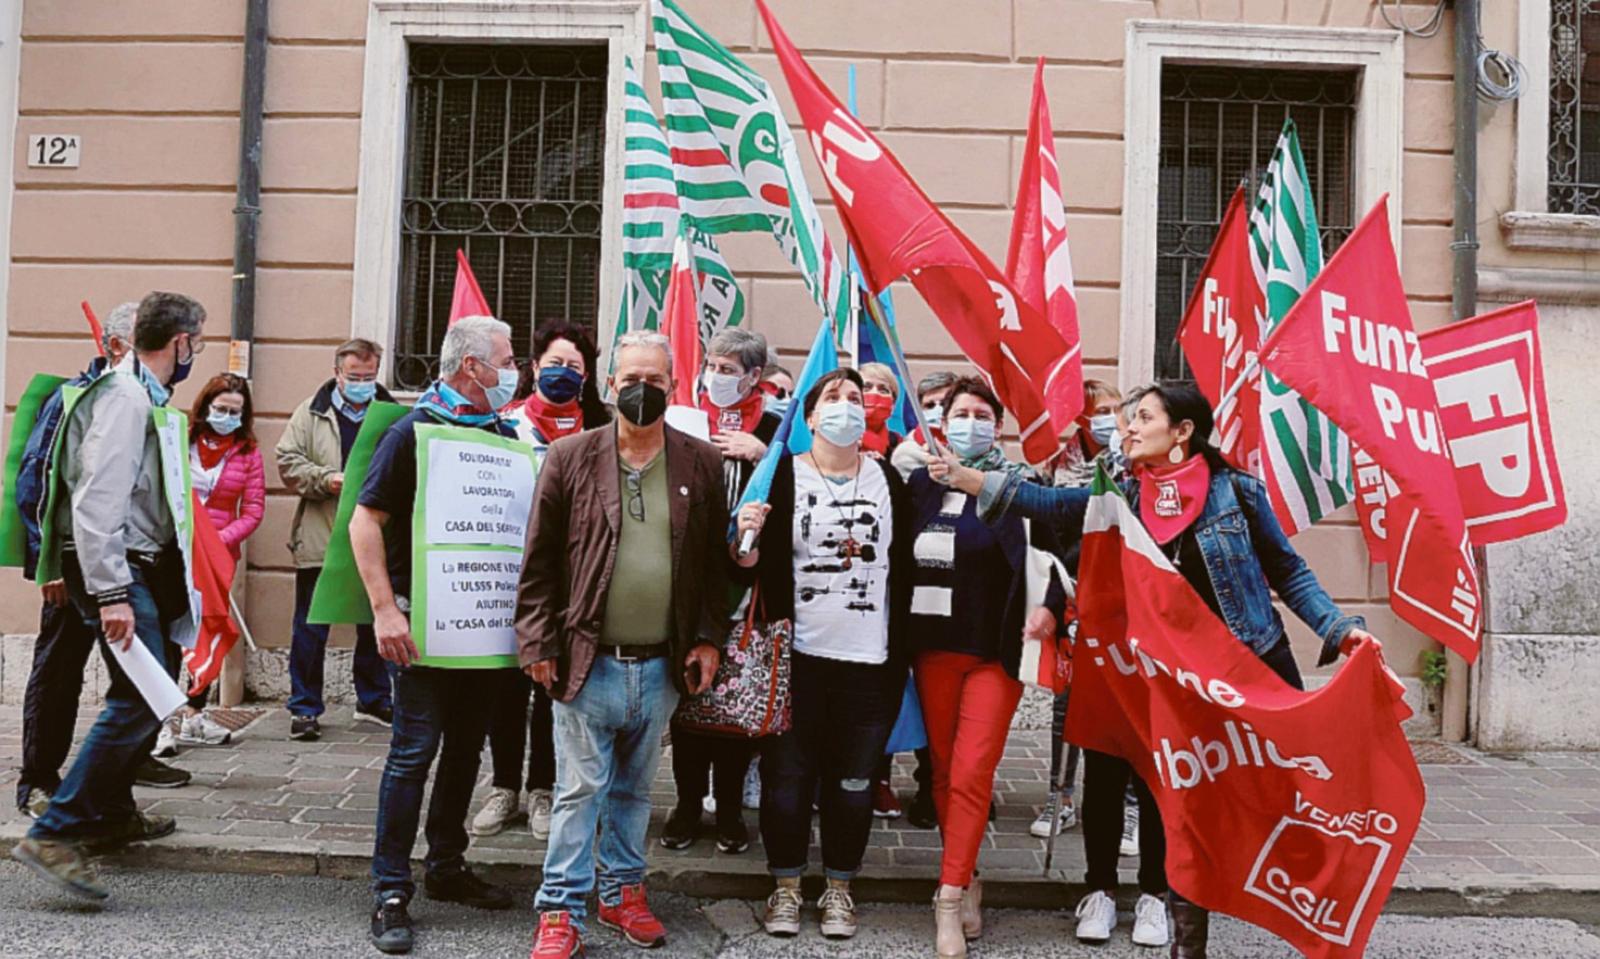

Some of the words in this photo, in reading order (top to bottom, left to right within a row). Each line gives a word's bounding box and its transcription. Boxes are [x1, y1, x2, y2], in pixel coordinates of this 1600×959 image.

[1370, 382, 1442, 455] Pu
[1432, 358, 1530, 498] FP
[444, 520, 474, 532] CASA
[475, 521, 495, 533] DEL
[457, 561, 503, 573] REGIONE
[487, 618, 503, 629] del
[1294, 790, 1398, 835] VENETO
[1266, 867, 1341, 928] CGIL
